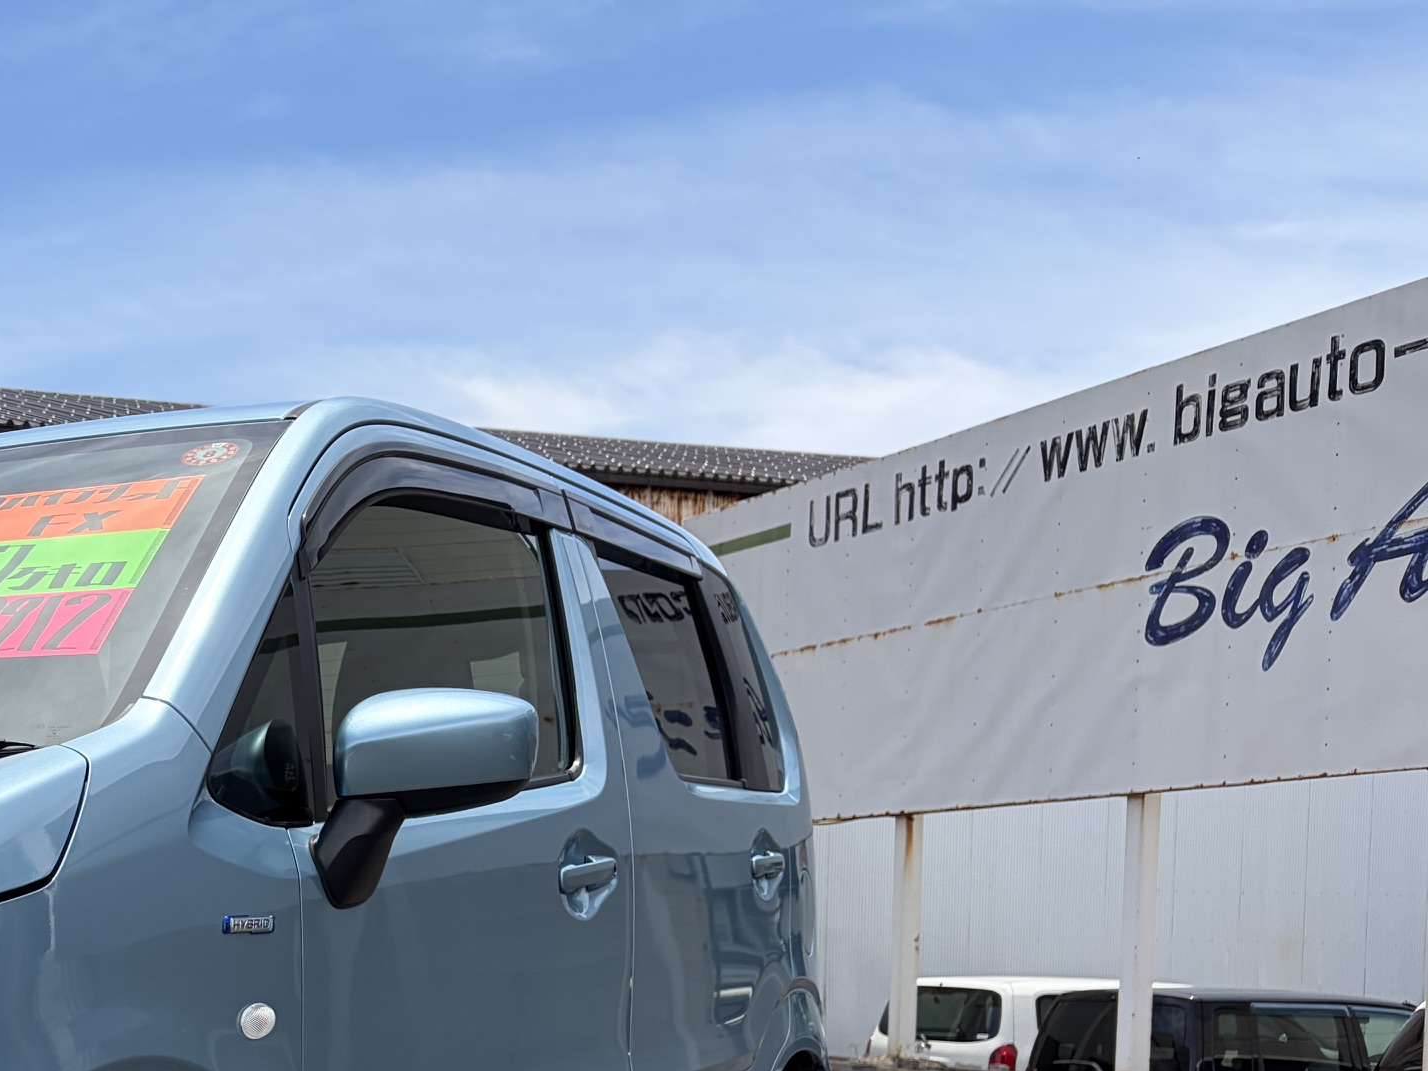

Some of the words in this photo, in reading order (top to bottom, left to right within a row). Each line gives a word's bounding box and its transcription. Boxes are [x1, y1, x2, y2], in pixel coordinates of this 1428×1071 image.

[27, 509, 122, 537] FX
[808, 483, 883, 548] URL
[1145, 515, 1314, 672] Big
[232, 918, 271, 930] HYBRID
